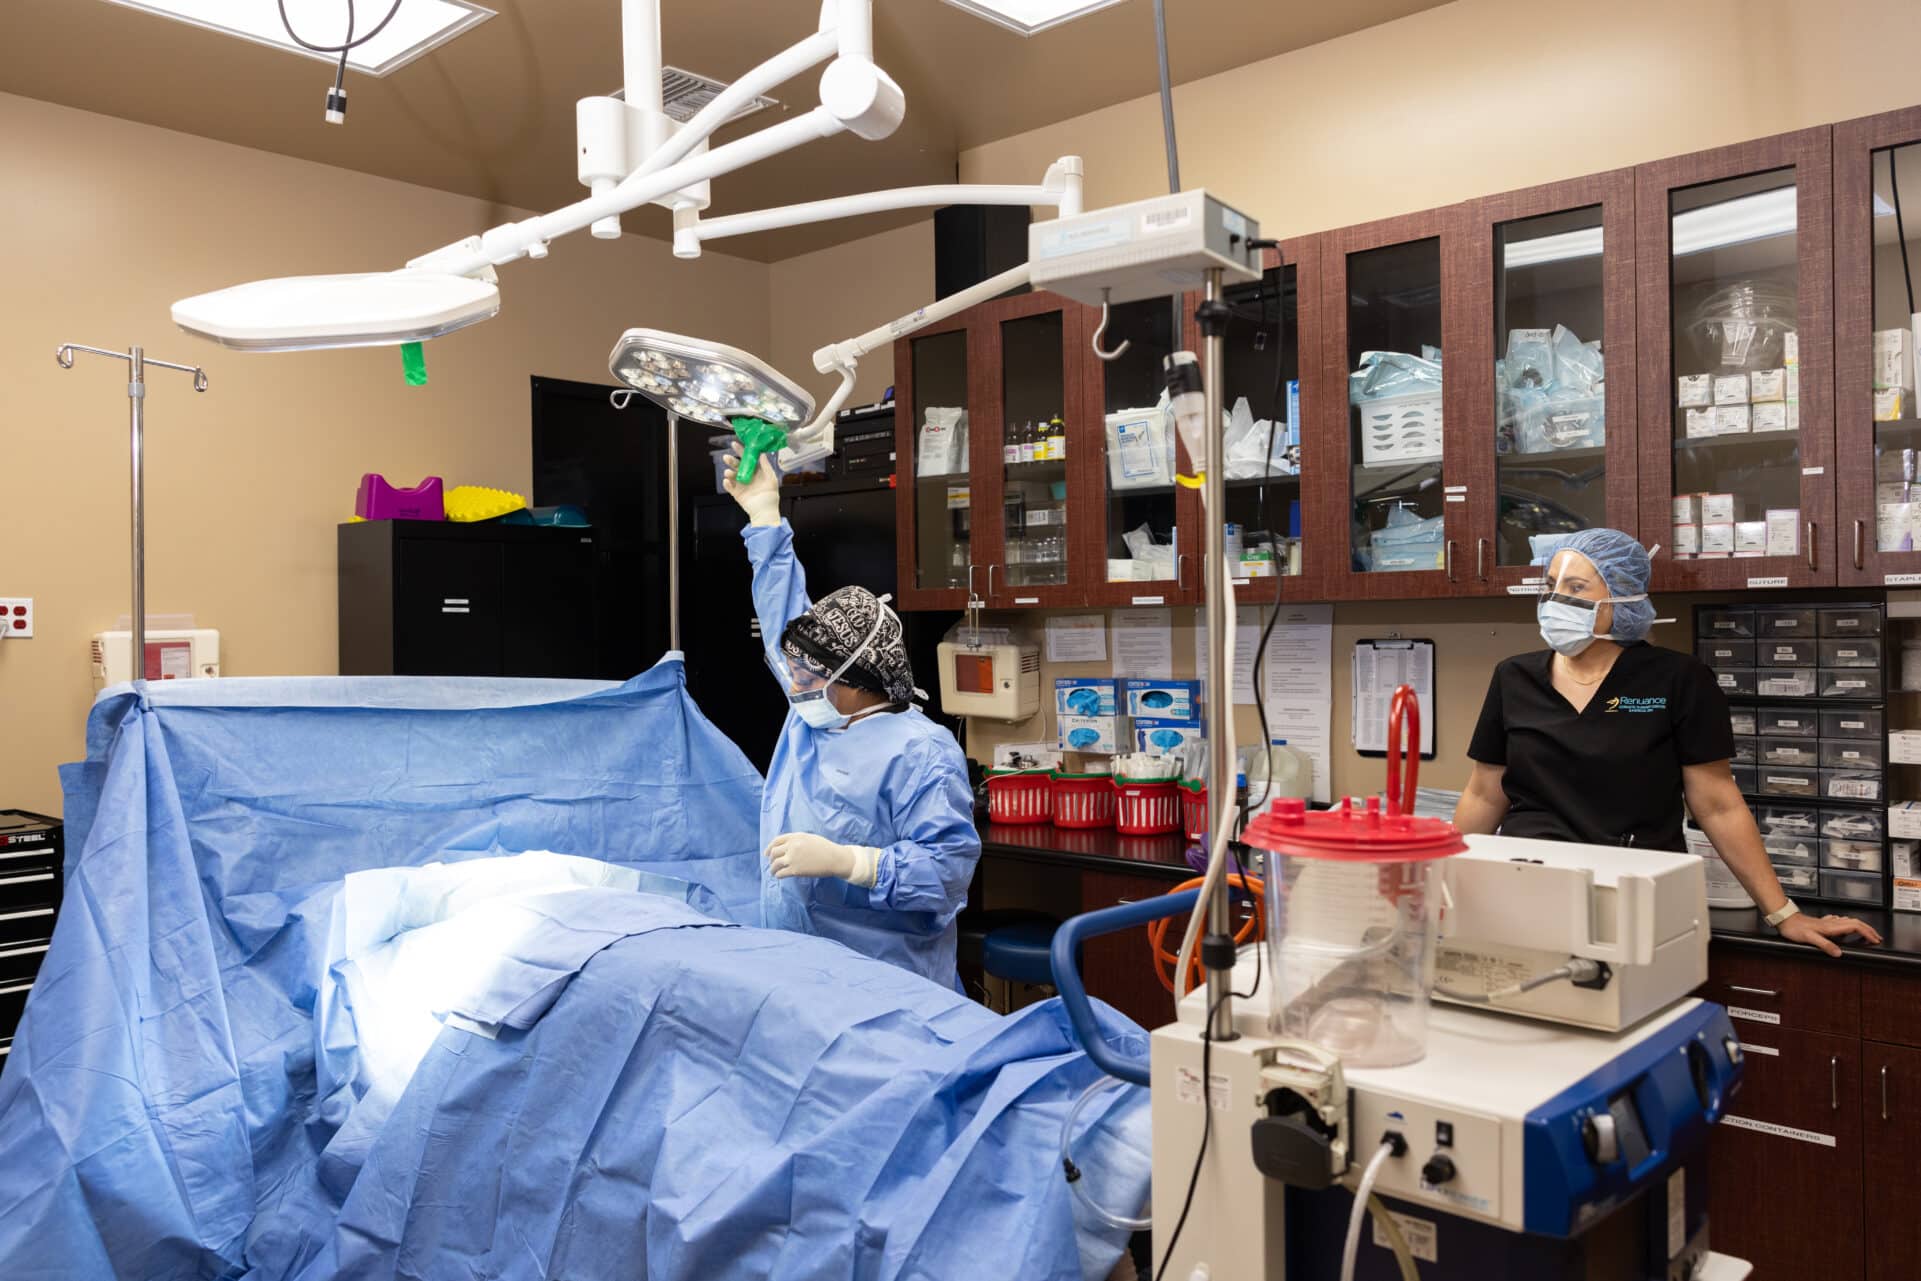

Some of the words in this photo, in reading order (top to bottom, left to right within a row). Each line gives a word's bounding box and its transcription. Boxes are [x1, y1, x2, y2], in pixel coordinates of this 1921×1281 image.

[1620, 696, 1666, 705] Renuance
[1730, 1009, 1777, 1021] FORCEPS
[1755, 1123, 1821, 1141] CONTAINERS
